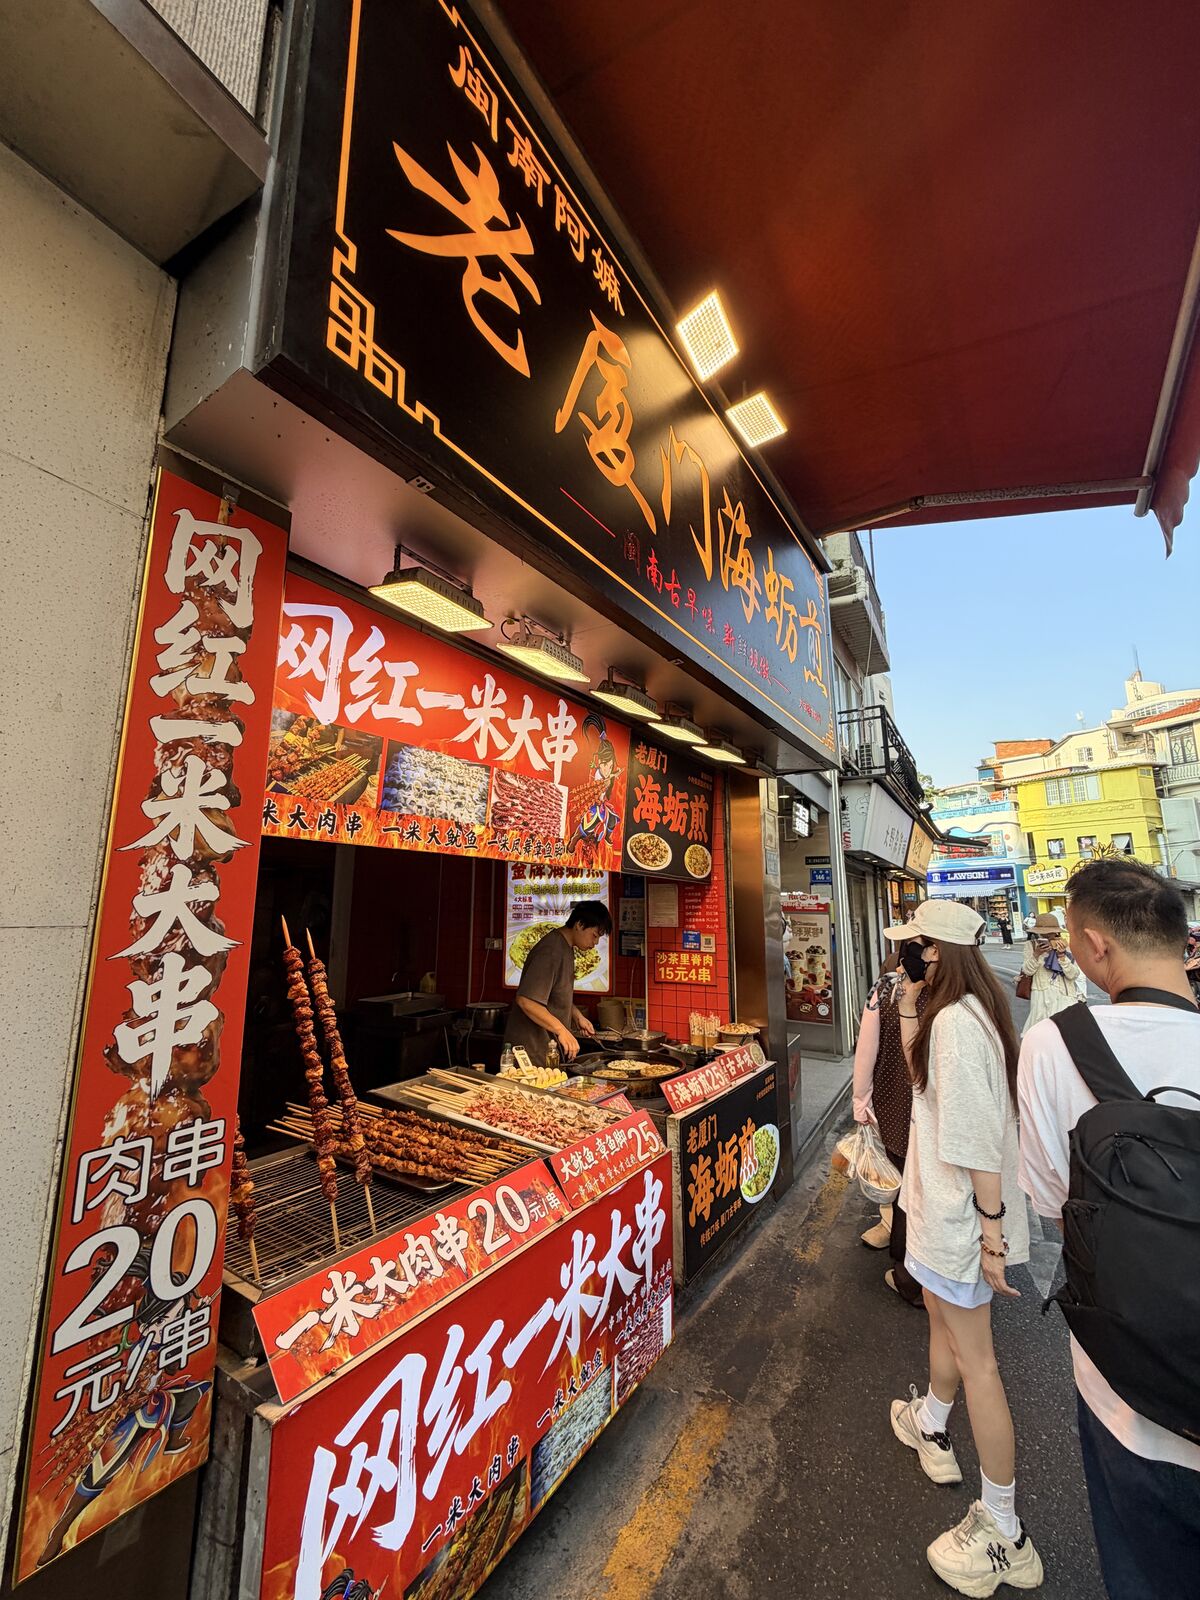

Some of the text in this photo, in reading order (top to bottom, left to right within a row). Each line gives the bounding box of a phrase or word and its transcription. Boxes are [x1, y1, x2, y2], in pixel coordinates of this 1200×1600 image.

[276, 602, 579, 787] 网红一米大串
[105, 507, 264, 1099] 网红一米大串
[634, 741, 668, 775] 老厦门
[382, 820, 478, 850] 一米大鱿鱼
[633, 774, 709, 844] 海蛎煎
[947, 871, 985, 881] LAWSON
[656, 952, 713, 967] 沙茶里脊肉
[658, 967, 712, 983] 15元4串
[72, 1117, 226, 1225] 肉串
[627, 1120, 660, 1163] 25
[686, 1113, 718, 1154] 老厦门
[687, 1116, 759, 1229] 海蛎煎
[51, 1198, 219, 1358] 20
[276, 1213, 470, 1356] 一米大肉串
[50, 1305, 212, 1439] 元/串
[294, 1169, 667, 1600] 网红一米大串
[536, 1348, 604, 1428] 一米大鱿鱼
[421, 1435, 520, 1553] 一米大肉串
